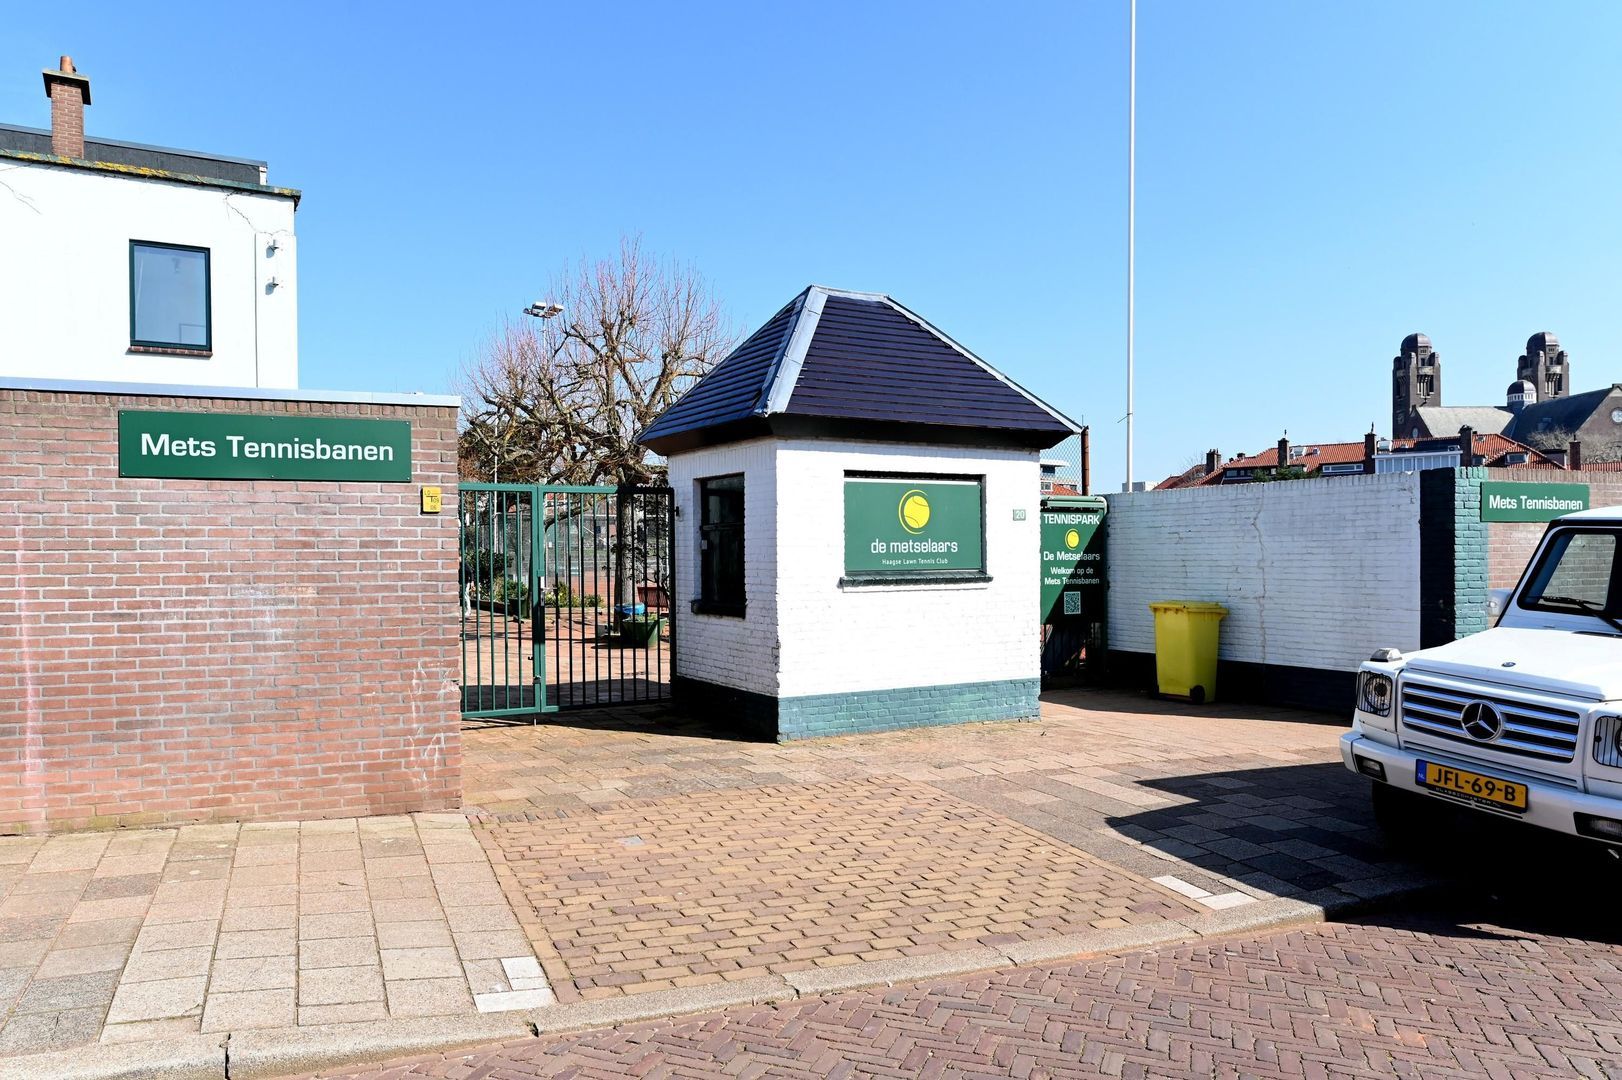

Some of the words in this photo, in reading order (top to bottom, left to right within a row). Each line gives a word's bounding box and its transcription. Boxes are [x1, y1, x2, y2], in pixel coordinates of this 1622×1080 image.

[141, 433, 216, 457] Mets
[226, 435, 394, 461] Tennisbanen
[1489, 495, 1517, 509] Mets
[1520, 495, 1583, 510] Tennisbanen
[1016, 511, 1025, 519] 20
[1043, 514, 1100, 525] TENNISPARK
[870, 538, 887, 554] de
[890, 538, 958, 553] metselaars
[1043, 551, 1054, 560] De
[1056, 551, 1100, 560] Metselaars
[882, 558, 902, 566] Haagse
[1050, 566, 1075, 574] Welkom
[1077, 568, 1085, 576] op
[1044, 577, 1060, 585] Mets
[1062, 577, 1100, 585] Tennisbanen
[1433, 768, 1516, 802] JFL-69-B
